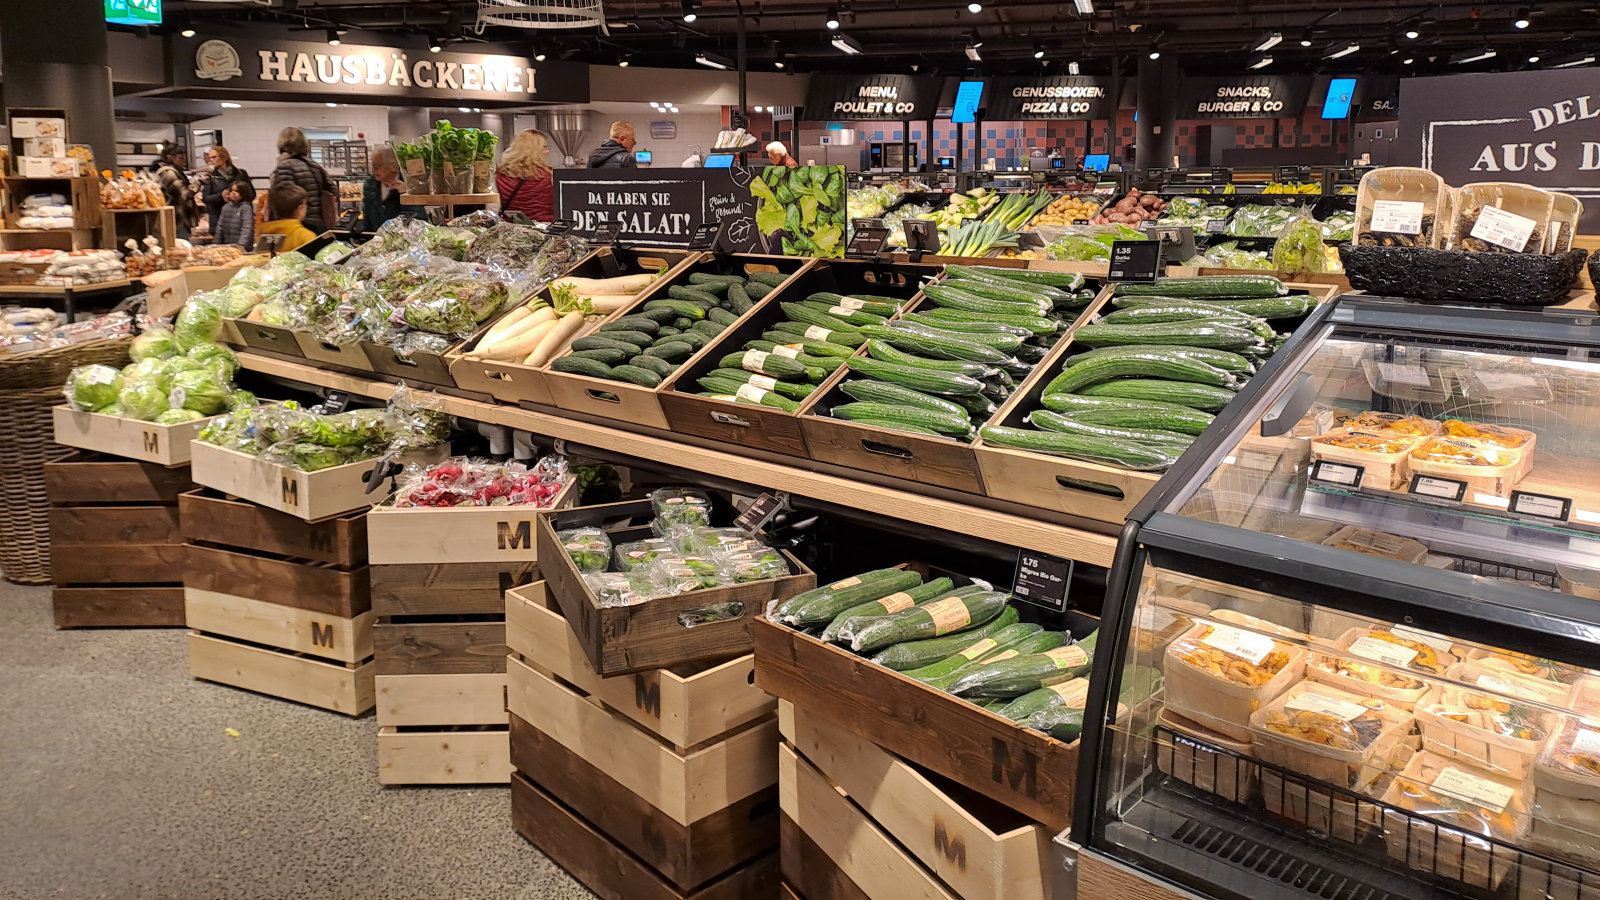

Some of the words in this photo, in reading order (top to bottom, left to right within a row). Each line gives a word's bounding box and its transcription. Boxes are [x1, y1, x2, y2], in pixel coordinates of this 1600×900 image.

[258, 50, 537, 94] HAUSBÄCKEREI
[858, 86, 898, 99] MENU,
[1012, 87, 1105, 99] GENUSSBOXEN,
[1216, 87, 1272, 99] SNACKS,
[834, 101, 883, 113] POULET
[884, 102, 894, 112] &
[895, 102, 914, 112] CO
[1021, 102, 1058, 113] PIZZA
[1059, 102, 1069, 113] &
[1070, 102, 1090, 113] CO
[1197, 102, 1250, 112] BURGER
[1251, 101, 1261, 112] &
[1262, 101, 1283, 111] CO
[1372, 100, 1395, 110] SA
[1528, 94, 1600, 132] DEL
[1469, 141, 1557, 172] AUS
[587, 191, 603, 205] DA
[606, 192, 647, 206] HABEN
[651, 192, 671, 206] SIE
[709, 194, 729, 212] grün
[571, 209, 610, 232] DEN
[616, 209, 691, 235] SALAT!
[715, 202, 744, 223] gesund!
[142, 431, 159, 455] M
[282, 476, 298, 507] M
[496, 520, 531, 550] M
[1021, 566, 1040, 576] Migros
[1023, 557, 1038, 567] 1.75
[311, 621, 334, 649] M
[635, 672, 661, 720] M
[991, 736, 1038, 800] M
[934, 820, 967, 871] M
